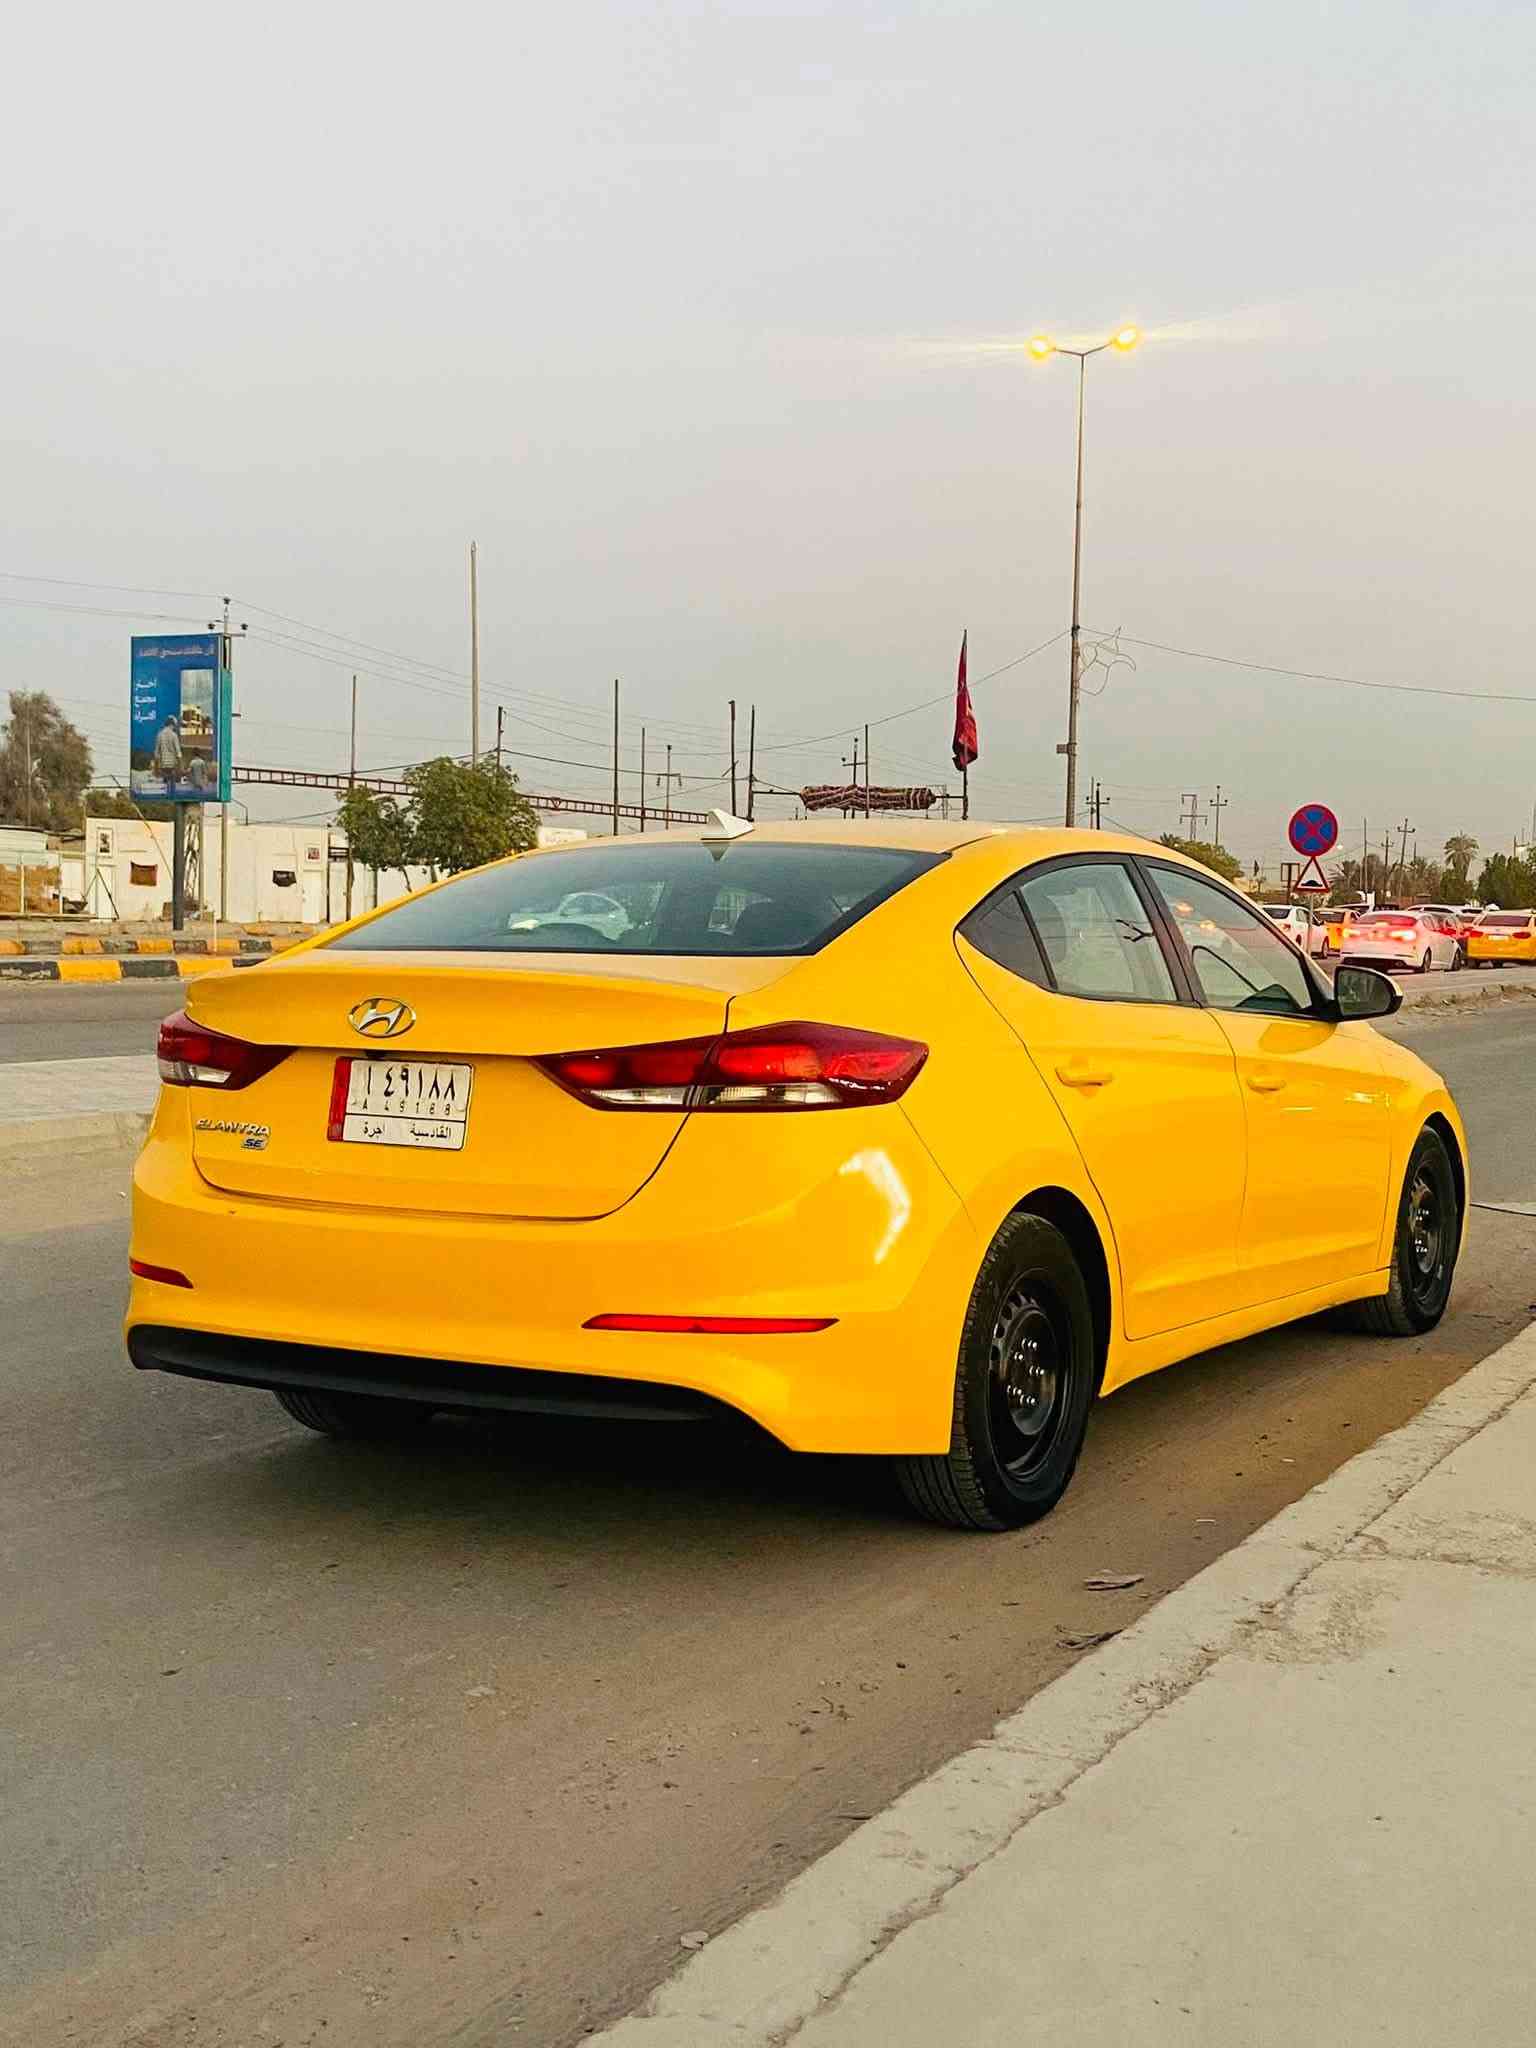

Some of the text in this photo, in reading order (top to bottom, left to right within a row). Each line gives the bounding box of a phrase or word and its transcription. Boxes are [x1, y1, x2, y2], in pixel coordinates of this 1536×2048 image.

[196, 1118, 271, 1137] ELANTRA
[410, 1122, 452, 1141] القادسية
[243, 1138, 264, 1149] SE
